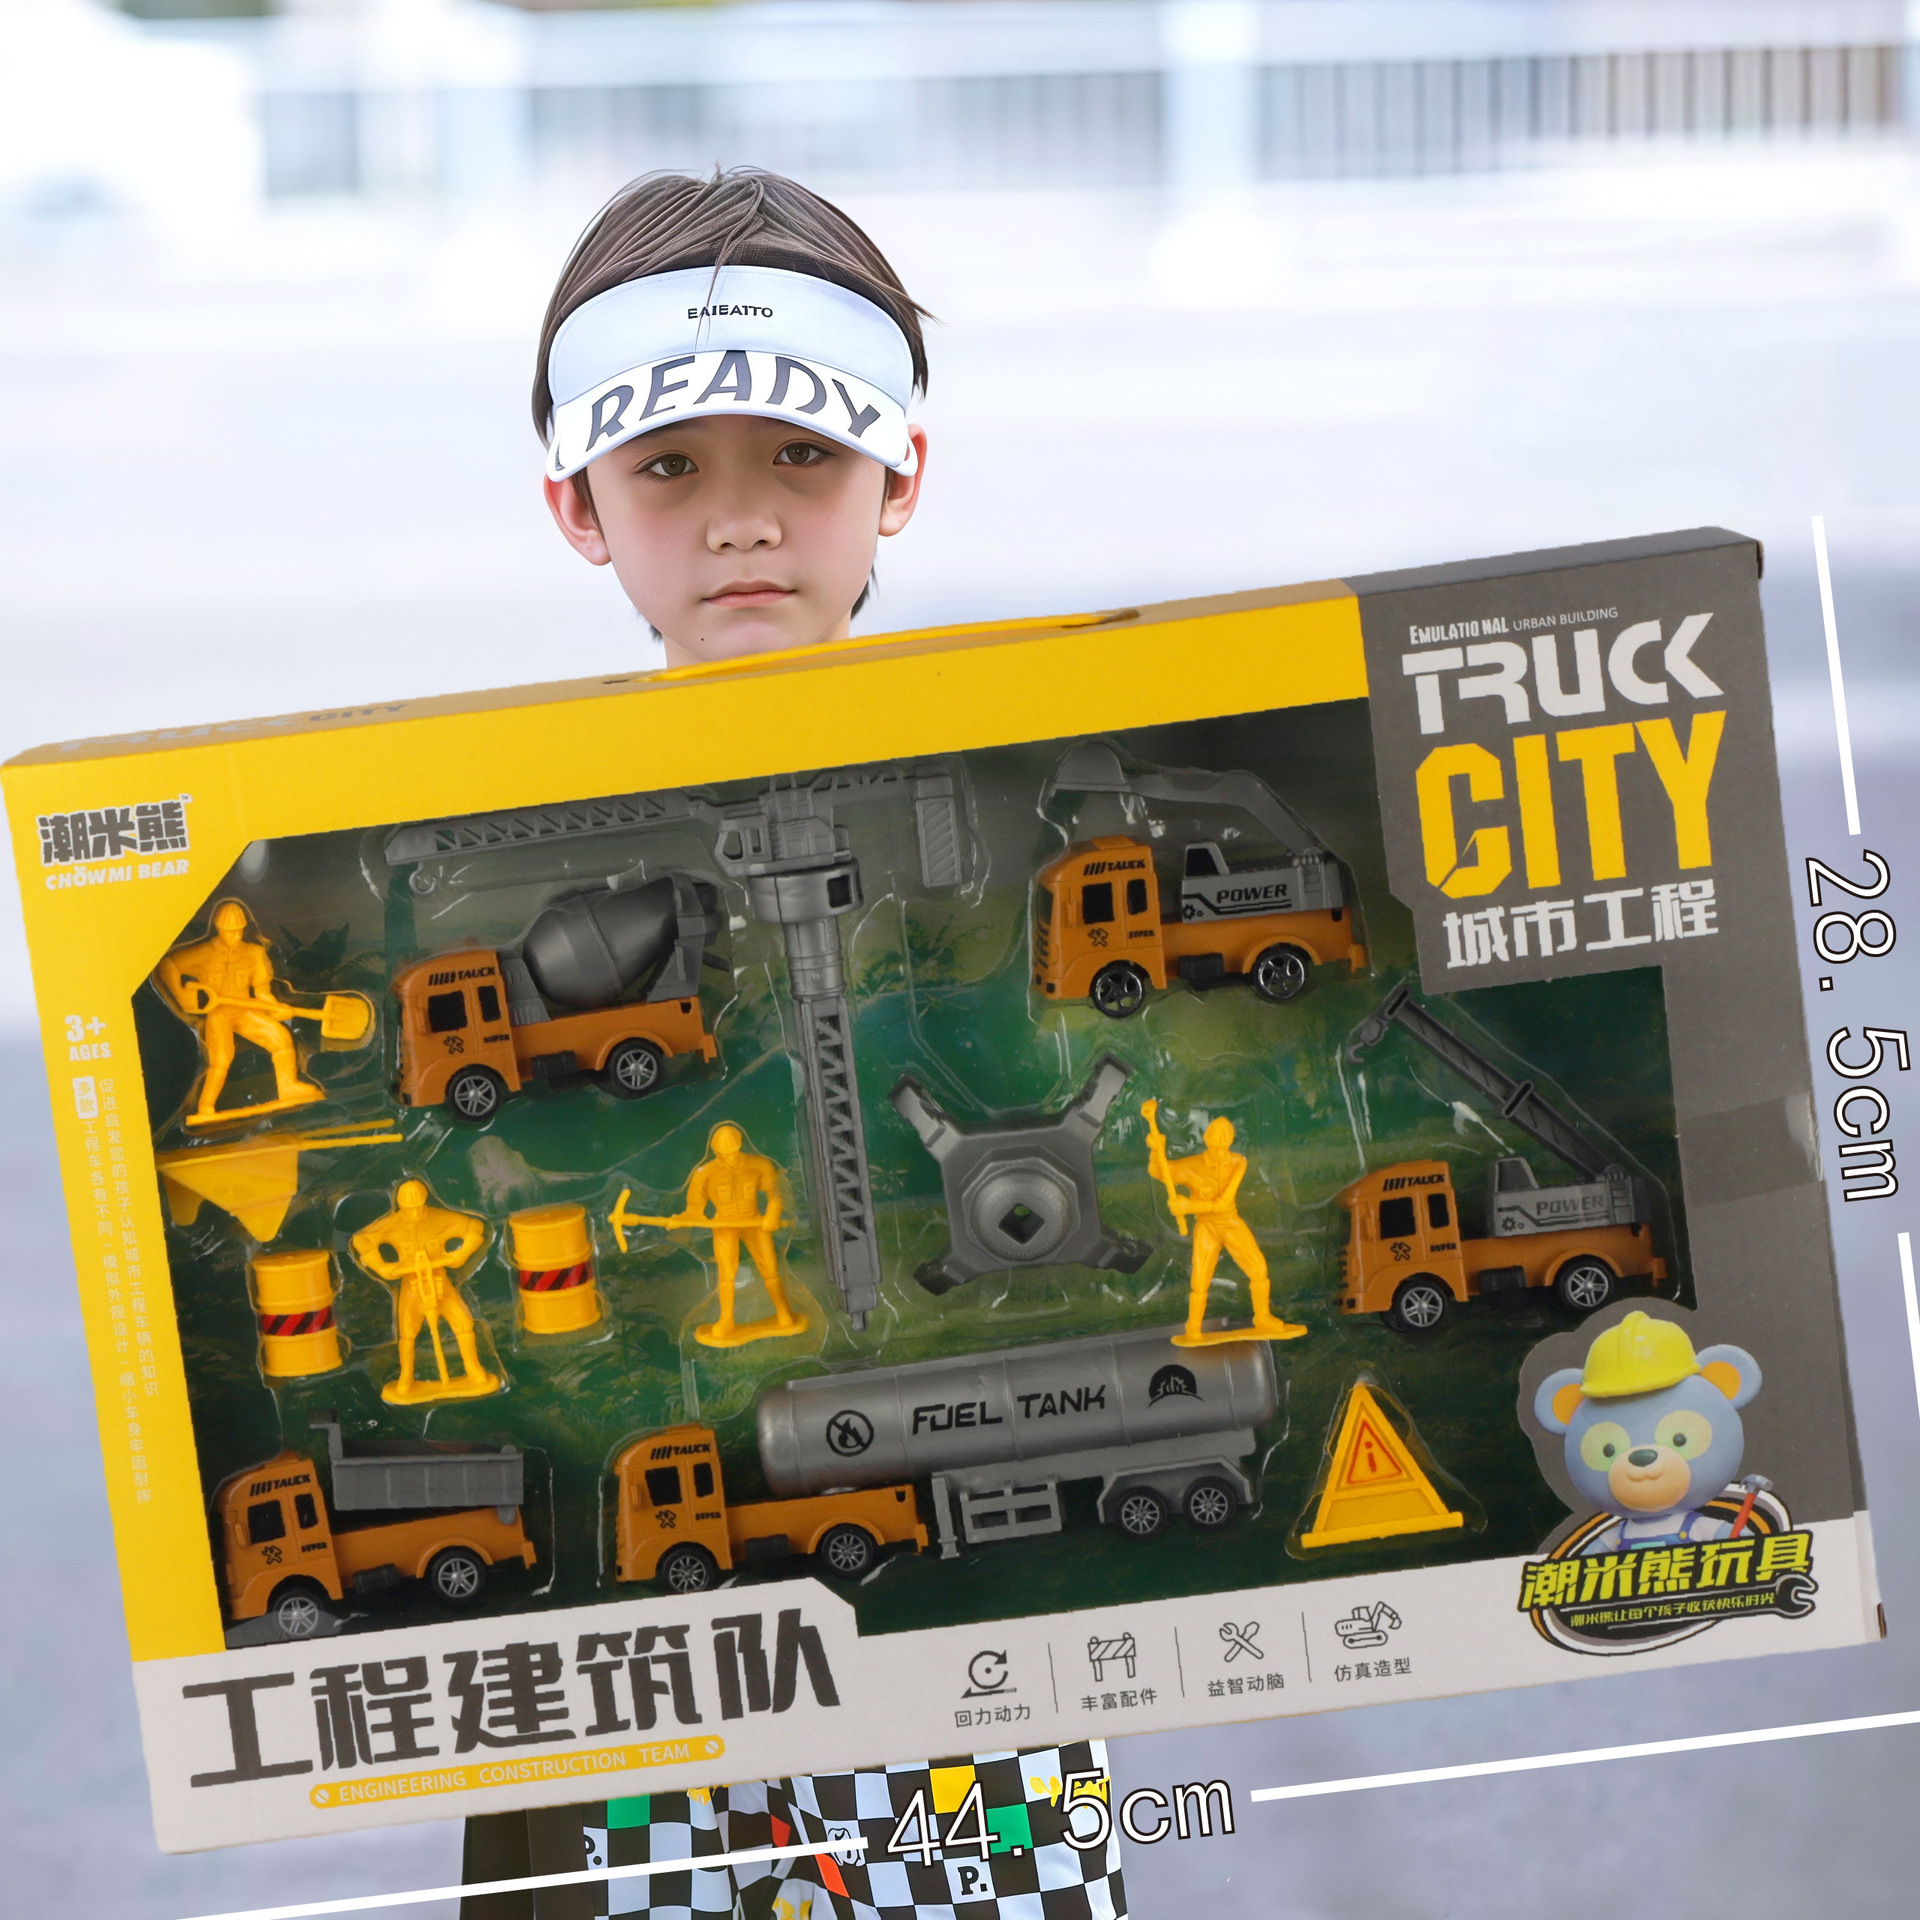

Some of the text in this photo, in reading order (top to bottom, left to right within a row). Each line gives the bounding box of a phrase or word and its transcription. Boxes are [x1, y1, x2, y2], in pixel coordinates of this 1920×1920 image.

[586, 350, 881, 452] READY
[1513, 616, 1556, 632] URBAN
[1560, 607, 1618, 626] BUILDING
[1402, 612, 1724, 735] TRUCK
[309, 703, 408, 721] CITY
[1415, 710, 1727, 899] CITY
[37, 801, 188, 864] 潮米熊
[138, 859, 189, 879] BEAR
[1216, 884, 1287, 903] POWER
[1443, 879, 1719, 969] 城市工程
[64, 1014, 106, 1042] 3+
[69, 1042, 112, 1061] AGES
[1537, 1195, 1604, 1215] POWER
[912, 1384, 1105, 1435] FUEL TANK
[1521, 1533, 1811, 1609] 潮米熊玩具
[1333, 1656, 1412, 1682] 仿真造型
[182, 1608, 841, 1787] 工程建筑队
[1207, 1672, 1285, 1698] 益智动脑
[1081, 1688, 1158, 1712] 丰富配件
[954, 1704, 1032, 1729] 回力动力
[338, 1743, 691, 1802] ENGINEERING CONSTRUCTION TEAM
